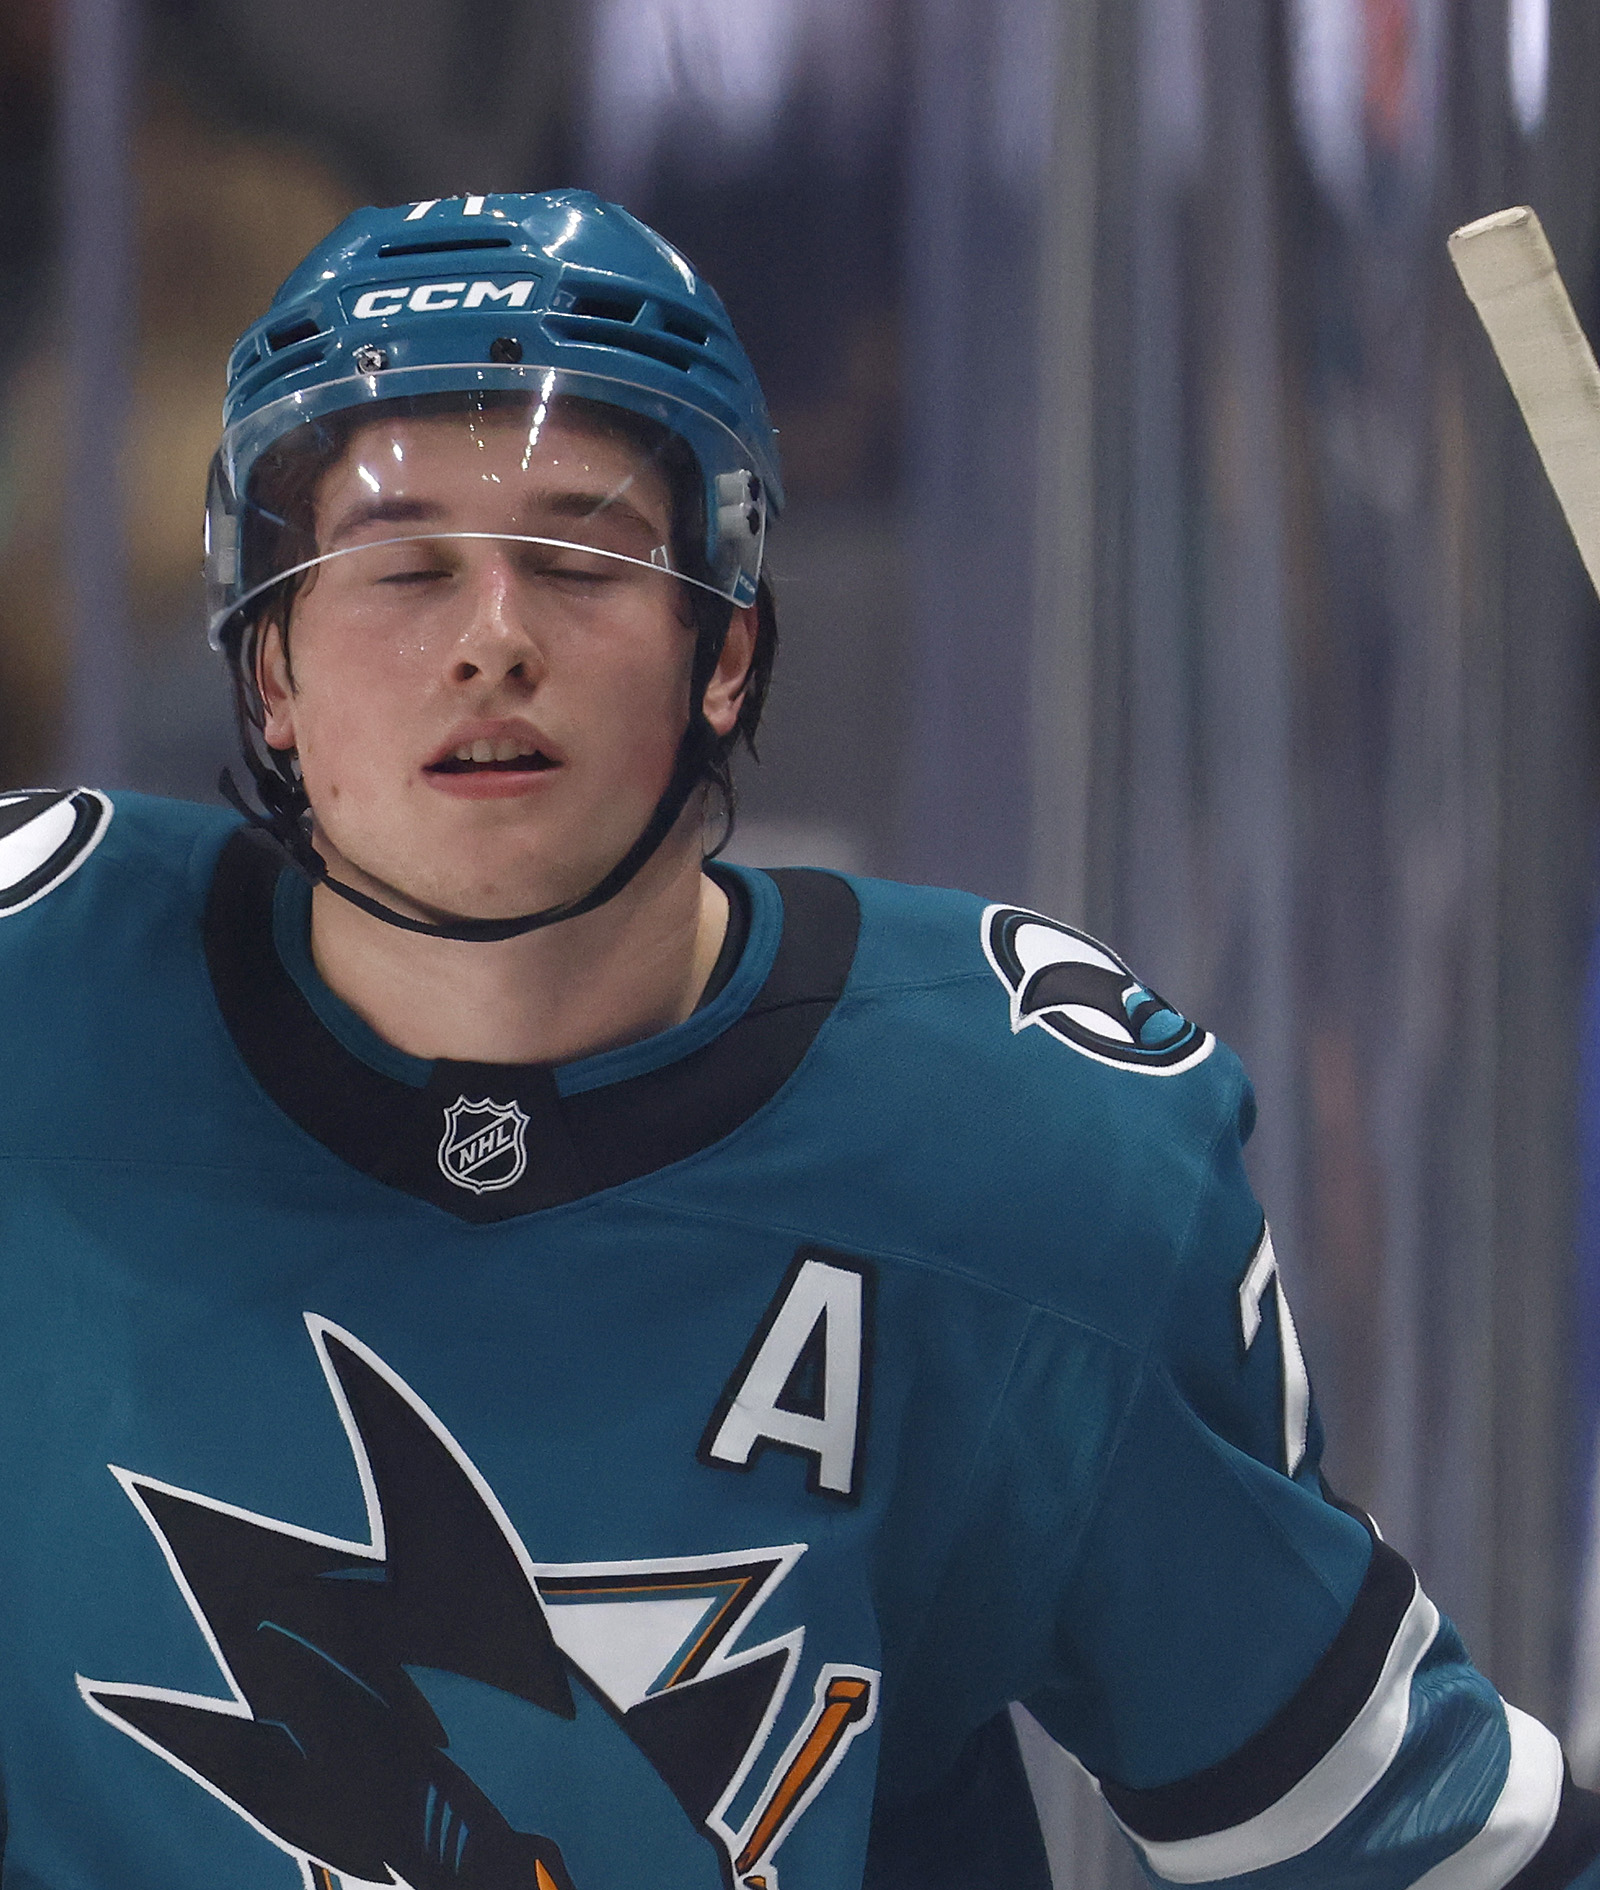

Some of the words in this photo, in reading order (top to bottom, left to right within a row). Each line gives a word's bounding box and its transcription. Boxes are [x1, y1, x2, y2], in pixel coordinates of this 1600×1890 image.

[352, 278, 537, 321] CCM
[458, 1124, 512, 1171] NHL
[703, 1252, 872, 1502] A
